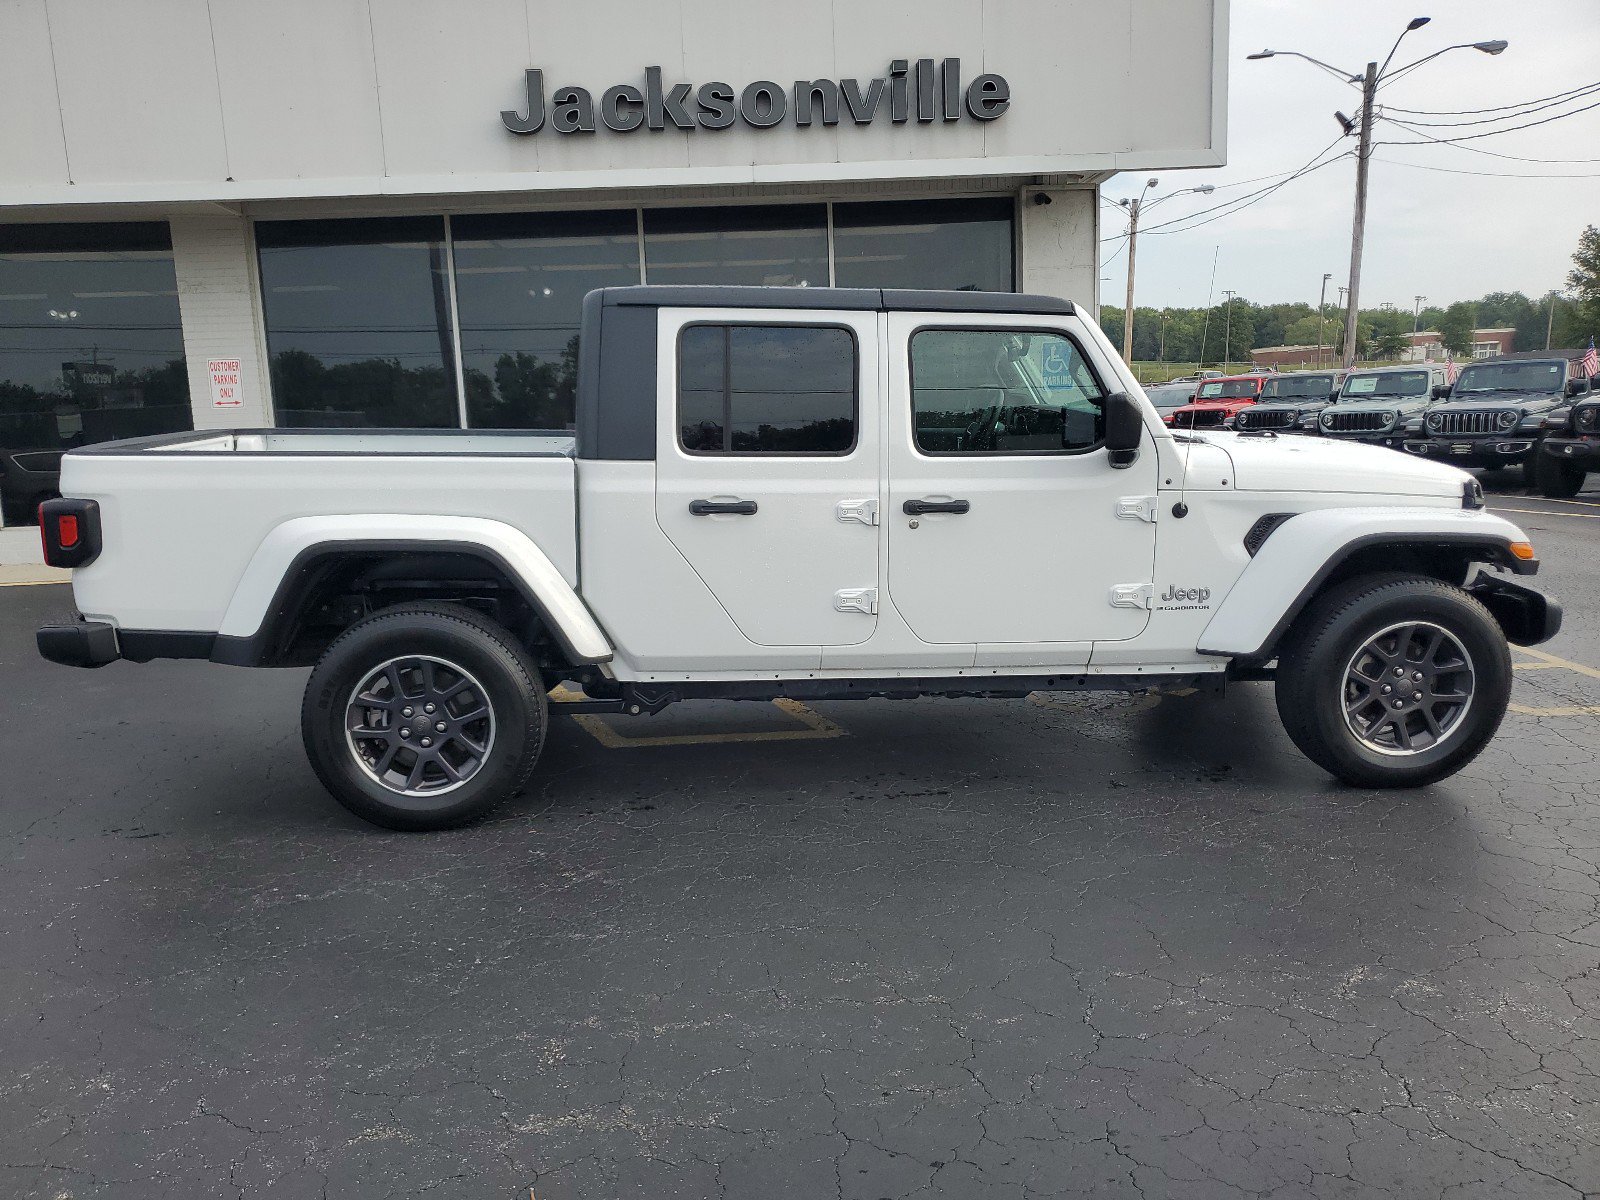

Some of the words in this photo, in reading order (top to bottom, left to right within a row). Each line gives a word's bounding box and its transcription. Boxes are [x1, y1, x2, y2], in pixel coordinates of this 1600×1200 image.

[500, 58, 1011, 135] Jacksonville
[210, 361, 239, 372] CUSTOMER
[213, 374, 238, 385] PARKING
[1043, 375, 1072, 386] PARKING
[220, 387, 234, 398] ONLY
[1161, 584, 1210, 603] Jeep
